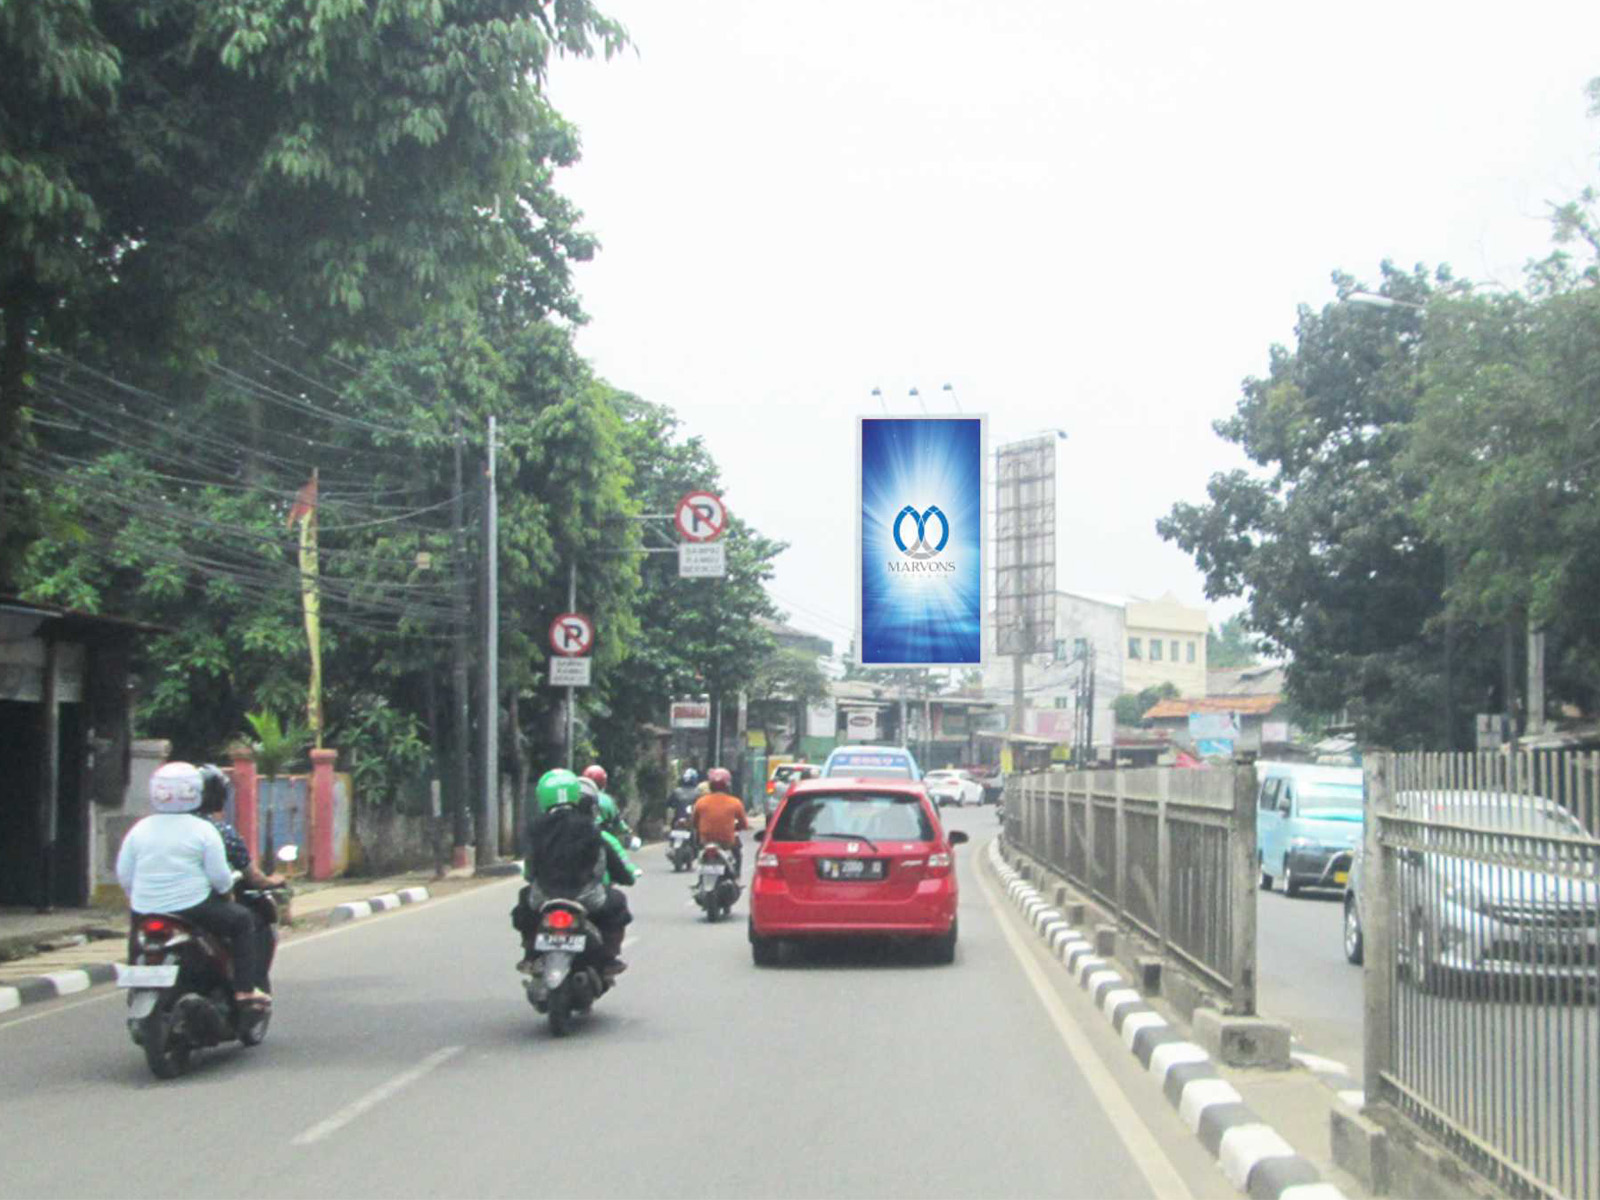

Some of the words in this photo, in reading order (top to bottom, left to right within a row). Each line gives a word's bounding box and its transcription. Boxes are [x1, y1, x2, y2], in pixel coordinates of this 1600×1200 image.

[692, 504, 714, 532] P
[888, 561, 956, 572] MARVONS
[564, 625, 583, 648] P
